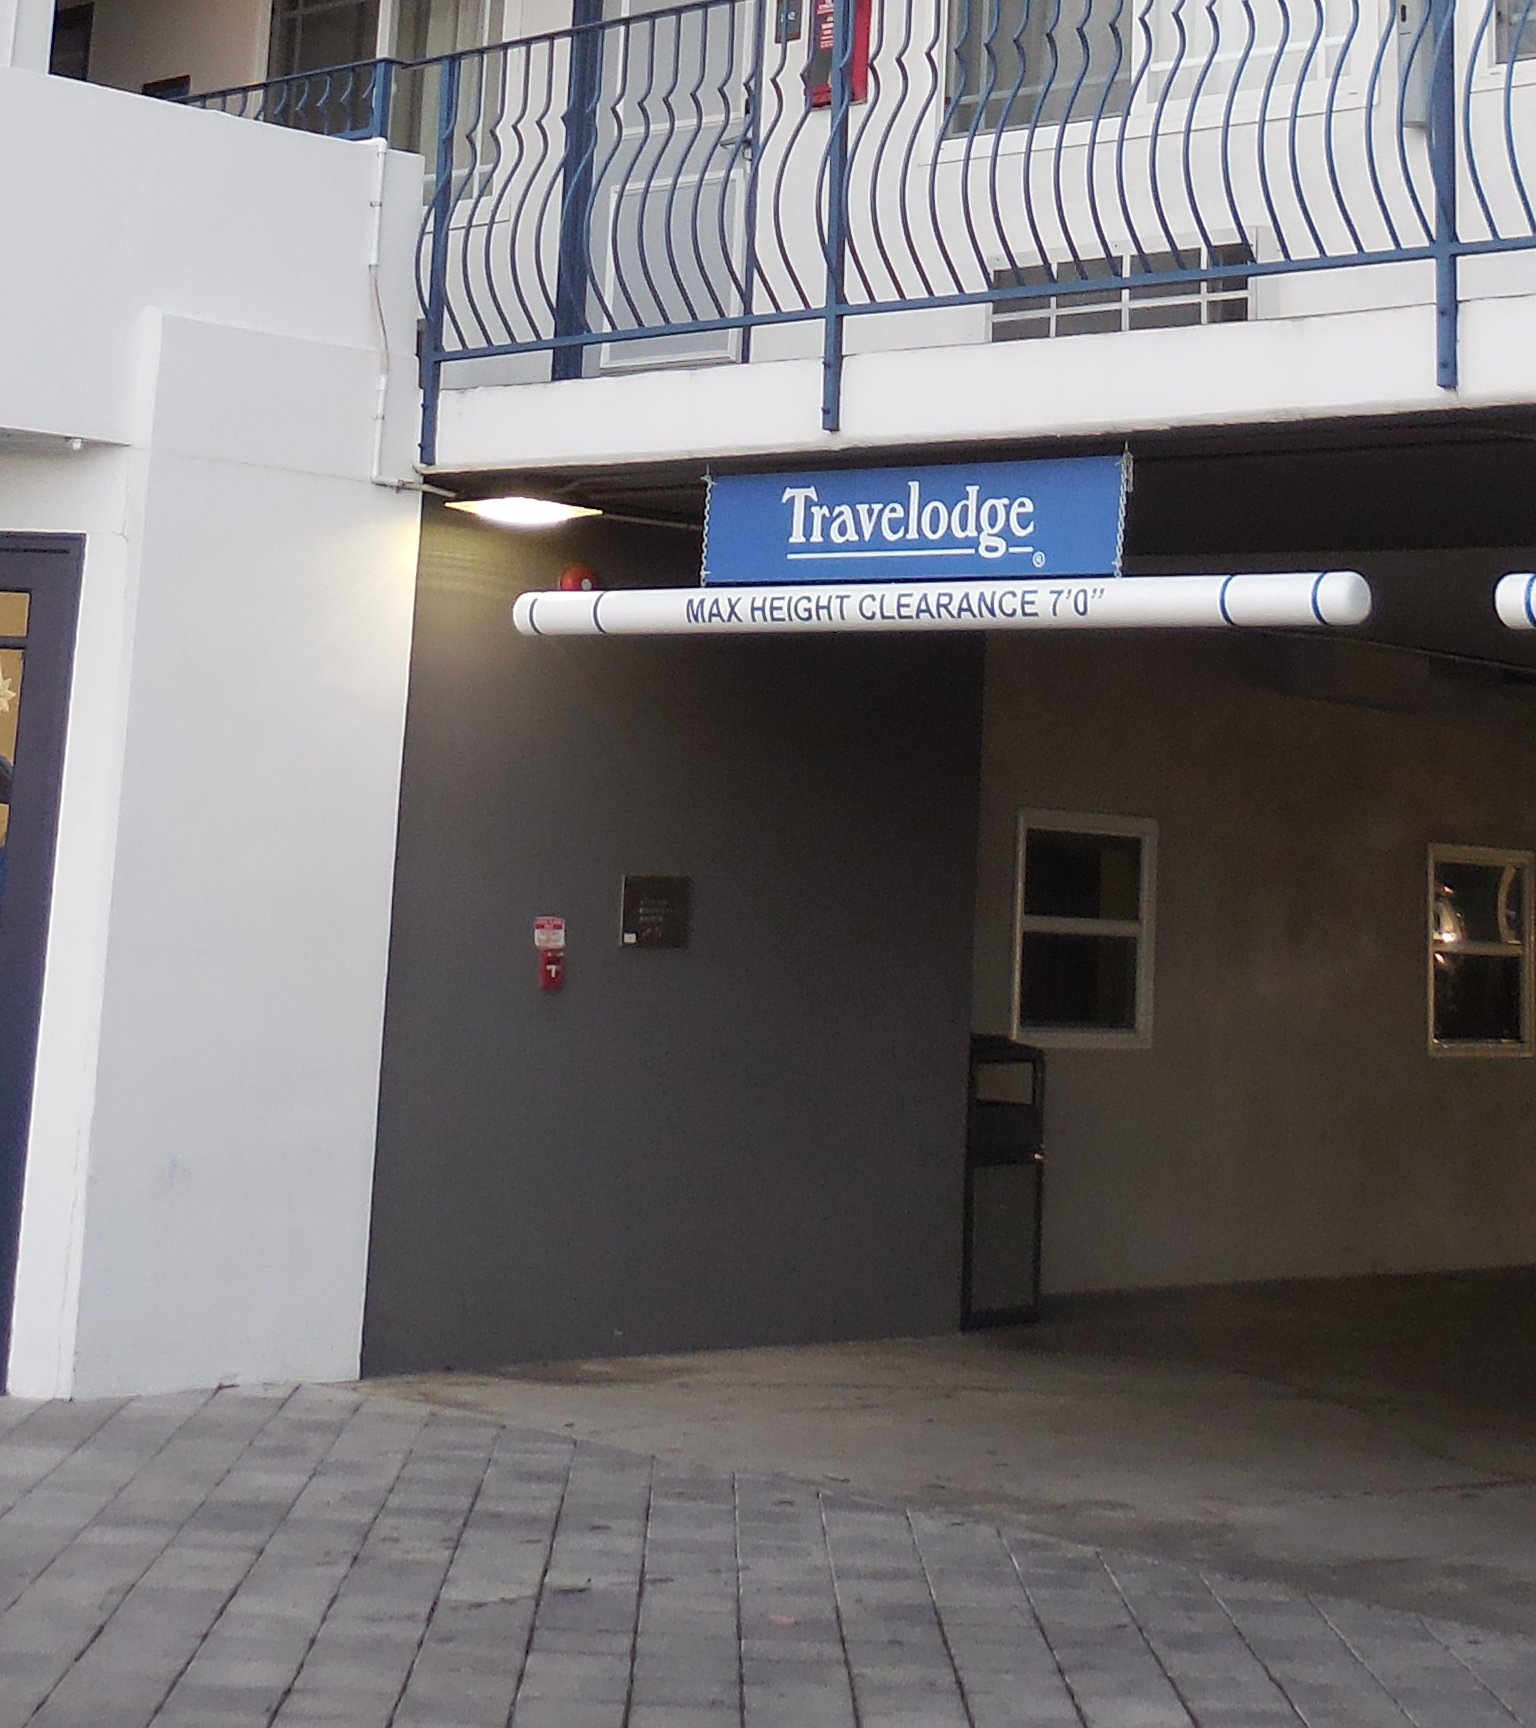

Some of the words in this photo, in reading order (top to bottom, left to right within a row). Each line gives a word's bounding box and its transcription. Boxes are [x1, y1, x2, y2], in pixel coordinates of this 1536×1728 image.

[781, 480, 1035, 559] Travelodge
[685, 595, 744, 623] MAX
[750, 594, 851, 623] HEIGHT
[858, 589, 1040, 621] CLEARANCE
